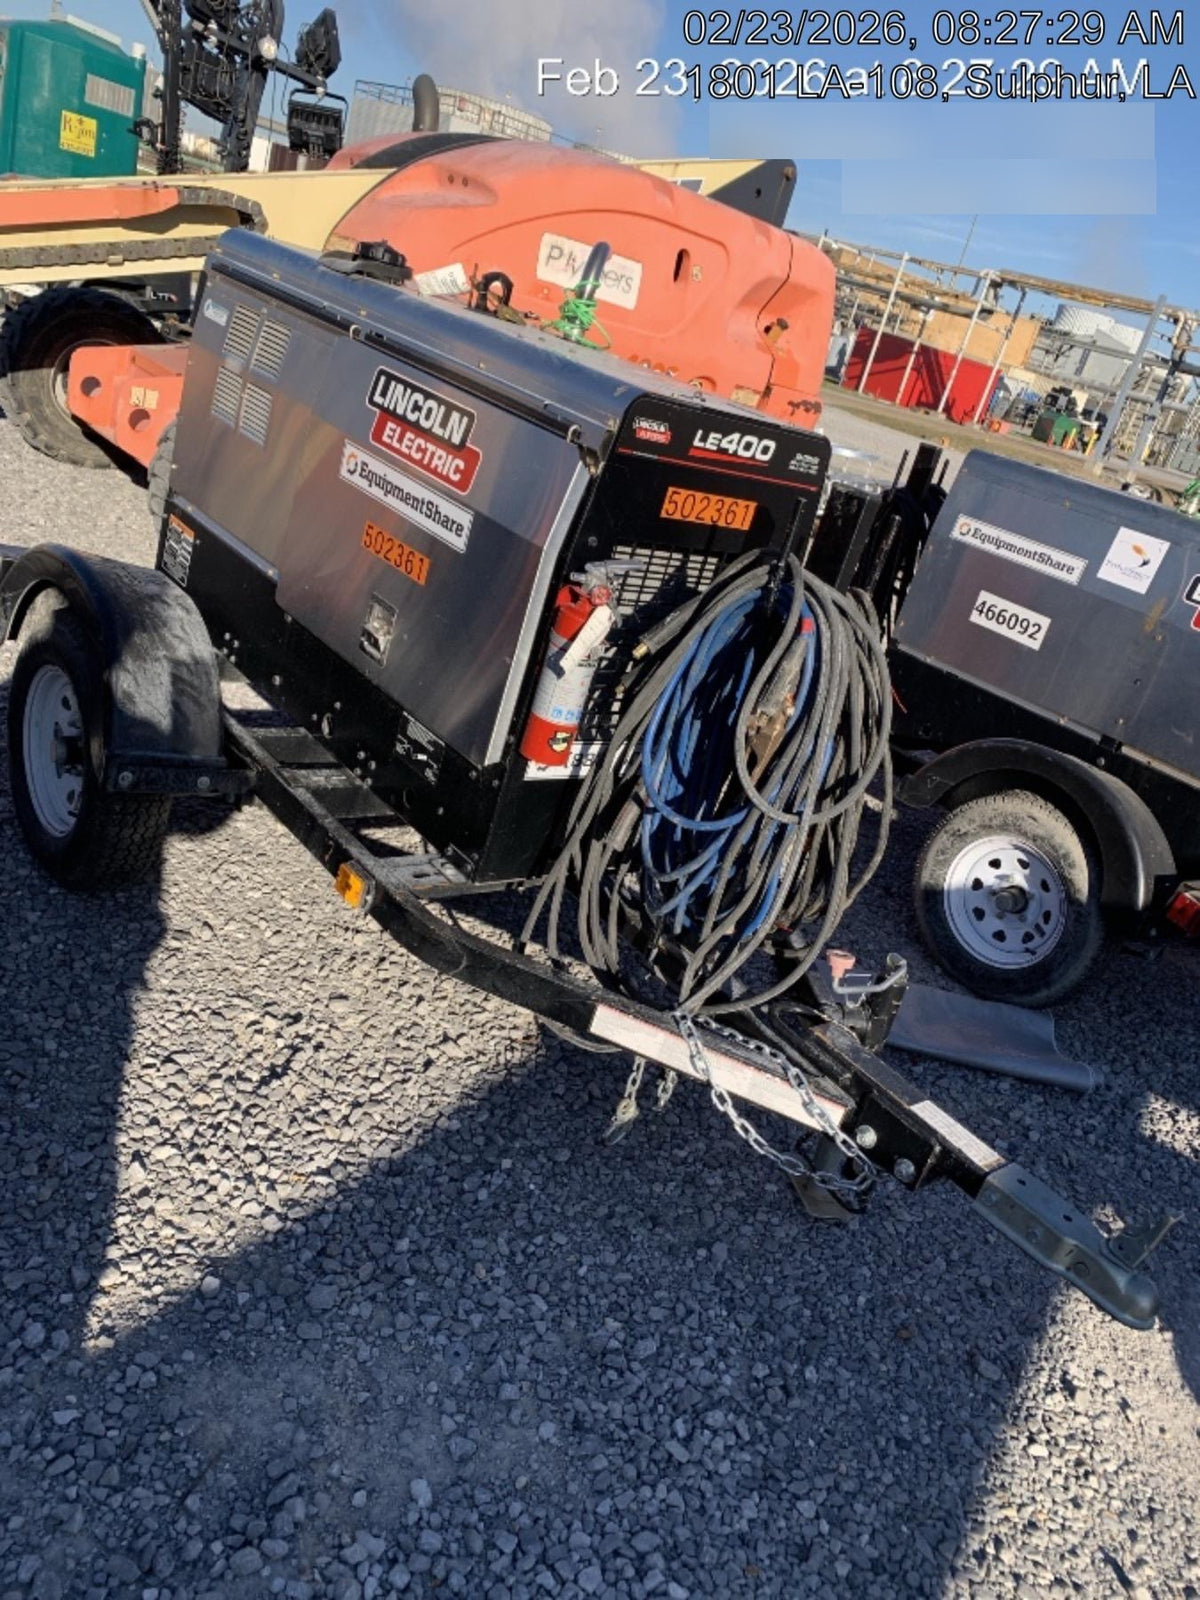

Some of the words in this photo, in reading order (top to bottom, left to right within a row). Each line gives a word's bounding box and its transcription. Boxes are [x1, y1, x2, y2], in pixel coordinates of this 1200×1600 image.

[373, 374, 469, 446] LINCOLN
[381, 420, 466, 483] ELECTRIC
[692, 429, 777, 462] LE400
[358, 460, 466, 538] EquipmentShare
[664, 490, 751, 527] 502361
[363, 524, 425, 582] 502361
[970, 526, 1076, 576] EquipmentShare
[974, 599, 1043, 641] 466092
